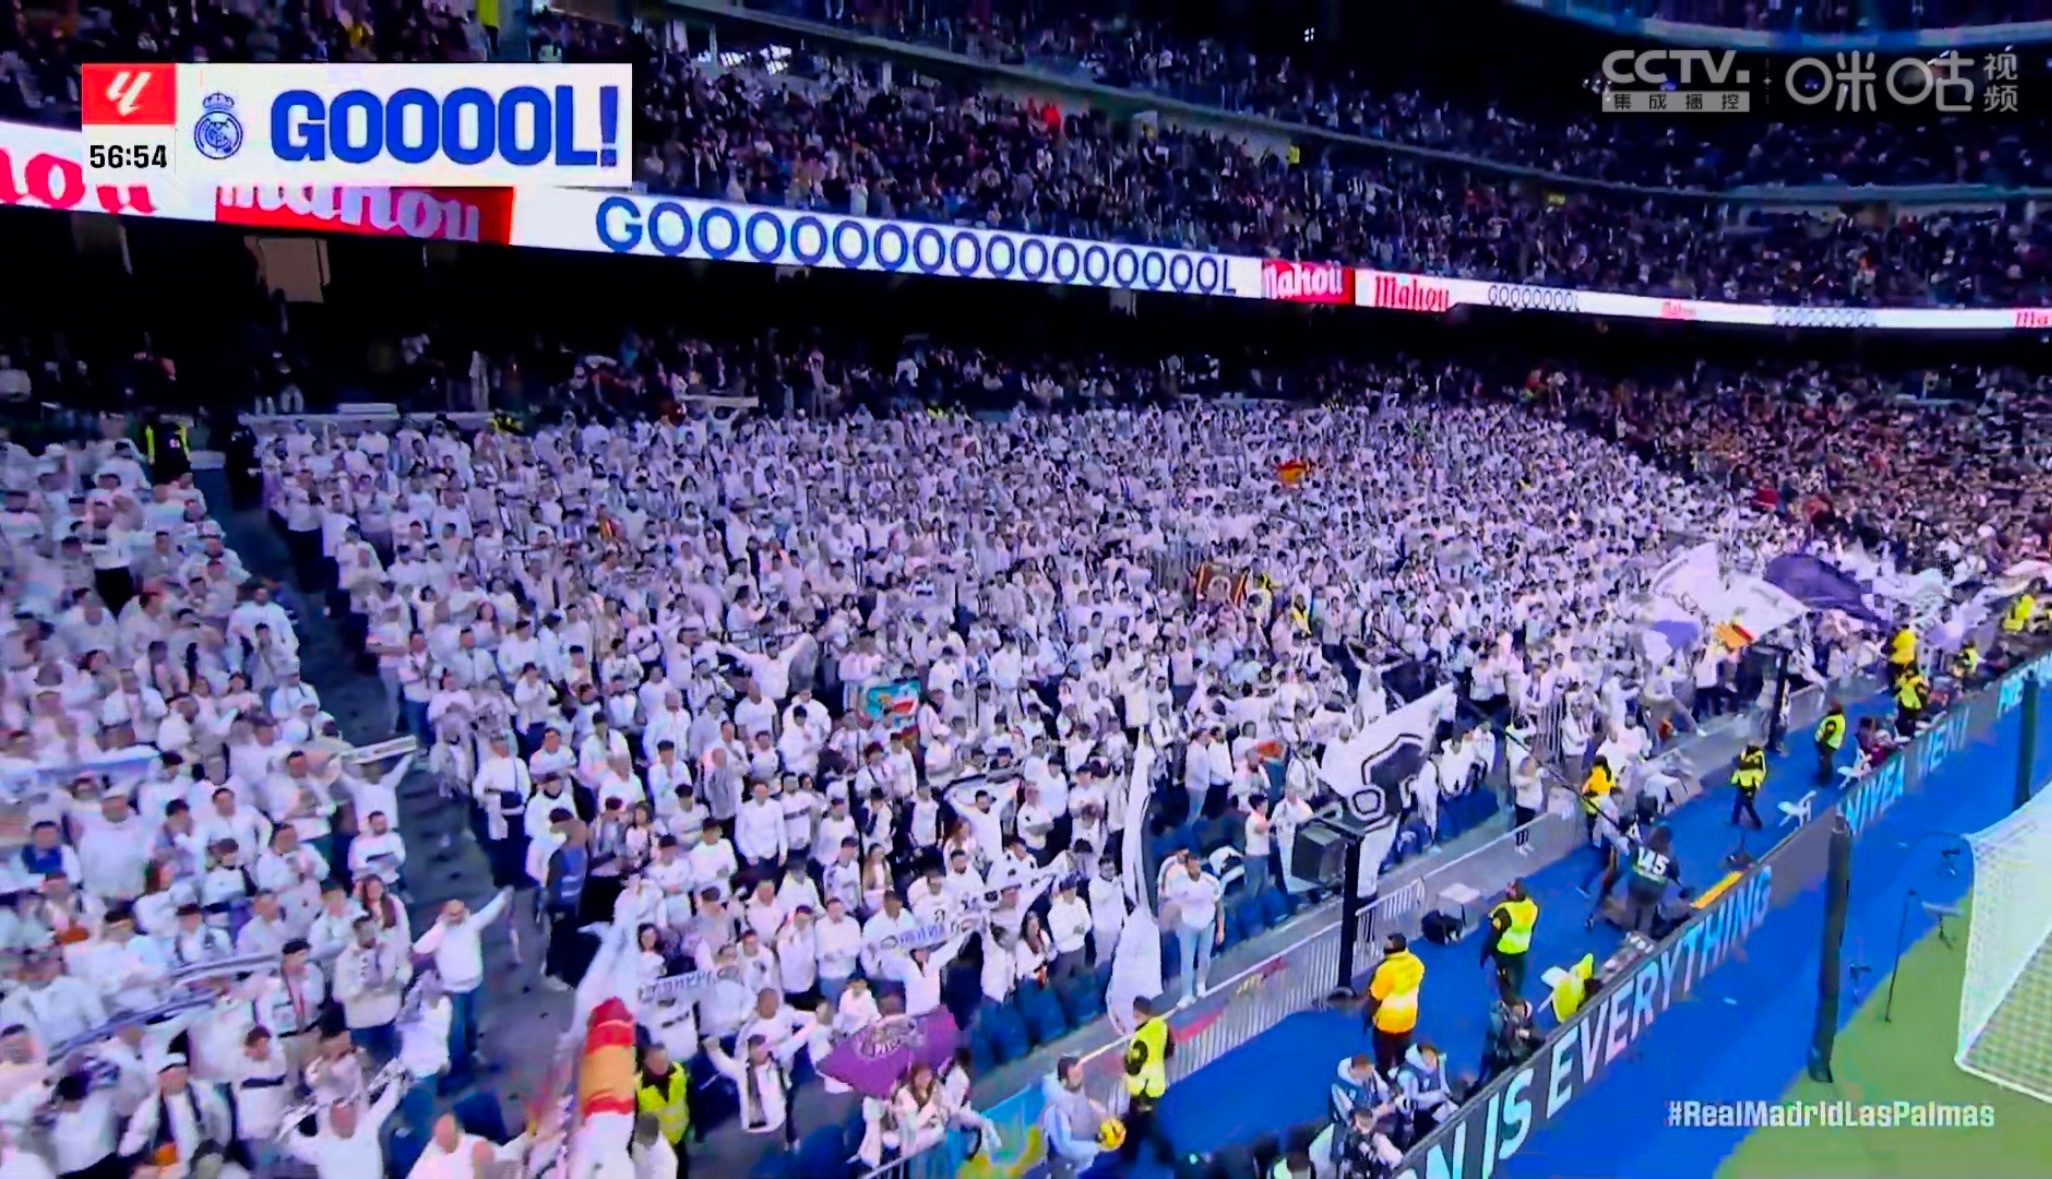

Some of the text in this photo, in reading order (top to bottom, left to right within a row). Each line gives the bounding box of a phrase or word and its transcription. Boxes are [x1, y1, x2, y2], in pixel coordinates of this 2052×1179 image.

[1375, 276, 1449, 311] Mahou
[1843, 752, 1905, 838] NIVEA
[1482, 1068, 1535, 1179] IS
[1547, 864, 1772, 1119] EVERYTHING
